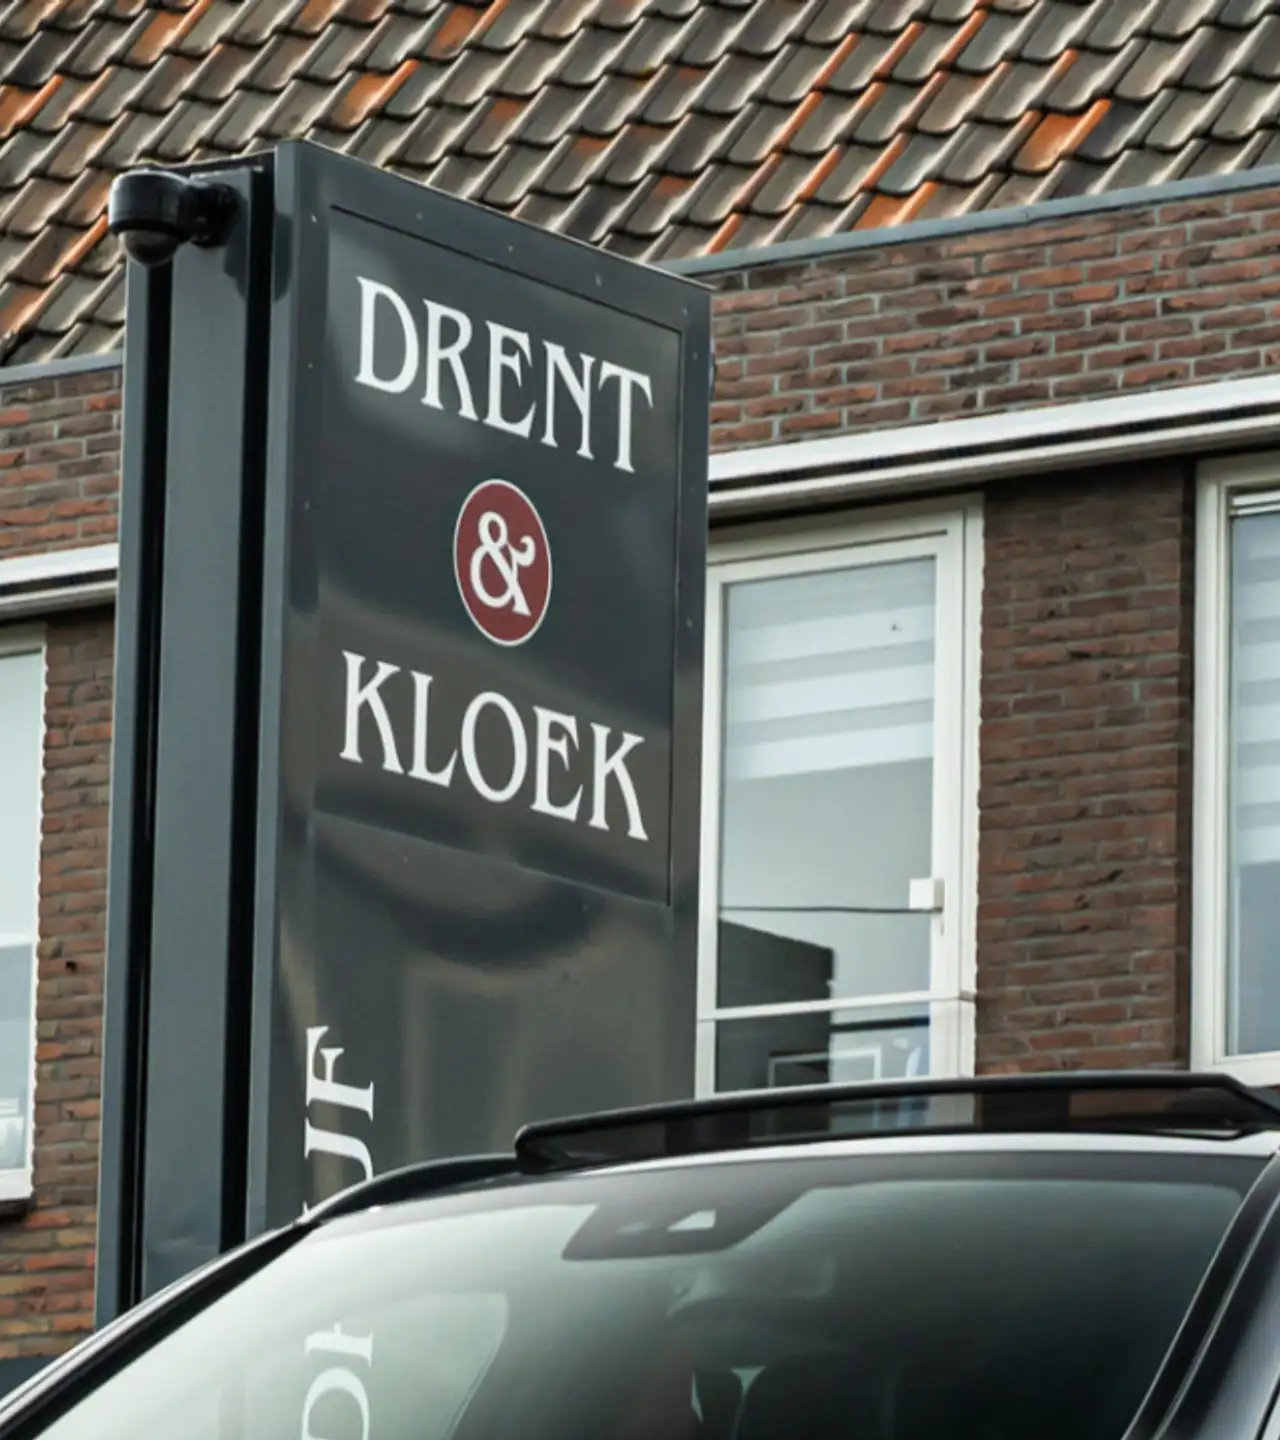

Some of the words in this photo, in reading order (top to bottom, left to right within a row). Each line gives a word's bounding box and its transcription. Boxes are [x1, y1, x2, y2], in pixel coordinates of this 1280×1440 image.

[354, 275, 654, 474] DRENT
[468, 510, 537, 617] &
[338, 649, 650, 842] KLOEK
